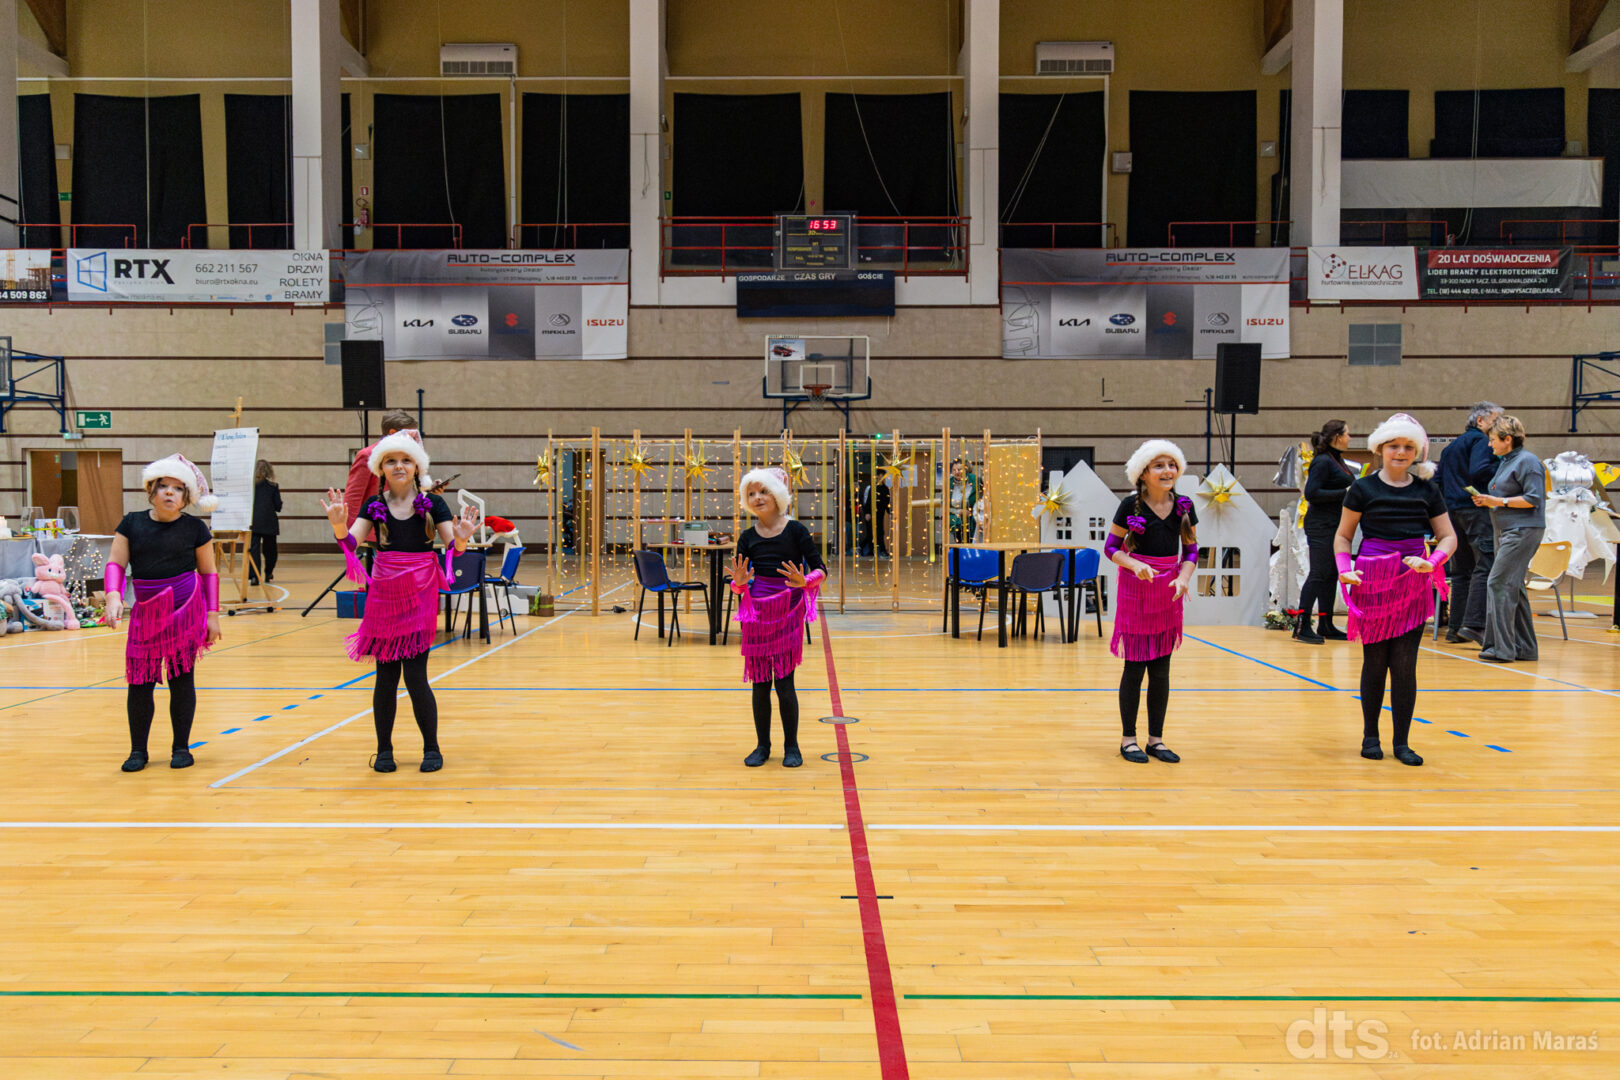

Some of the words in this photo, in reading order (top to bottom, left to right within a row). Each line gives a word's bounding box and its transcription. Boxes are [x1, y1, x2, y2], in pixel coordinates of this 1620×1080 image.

[809, 220, 820, 230] 16
[822, 220, 837, 230] 53
[292, 253, 323, 262] OKNA
[447, 253, 576, 264] AUTO-COMPLEX
[1106, 252, 1236, 262] AUTO-COMPLEX
[1438, 254, 1450, 264] 20
[1453, 254, 1471, 264] LAT
[1473, 252, 1551, 264] DOŚWIADCZENIA
[114, 259, 175, 285] RTX
[195, 263, 214, 273] 662
[217, 263, 235, 273] 211
[239, 263, 258, 273] 567
[287, 265, 323, 274] DRZWI
[1348, 264, 1403, 279] ELKAG
[1427, 268, 1448, 276] LIDER
[1449, 267, 1479, 276] BRANŻY
[794, 273, 816, 281] CZAS
[279, 278, 323, 287] ROLETY
[10, 291, 28, 299] 509
[29, 291, 47, 299] 862
[284, 290, 323, 299] BRAMY
[403, 319, 434, 328] KIA
[587, 319, 624, 327] ISUZU
[1059, 318, 1090, 327] KIA
[1246, 318, 1284, 326] ISUZU
